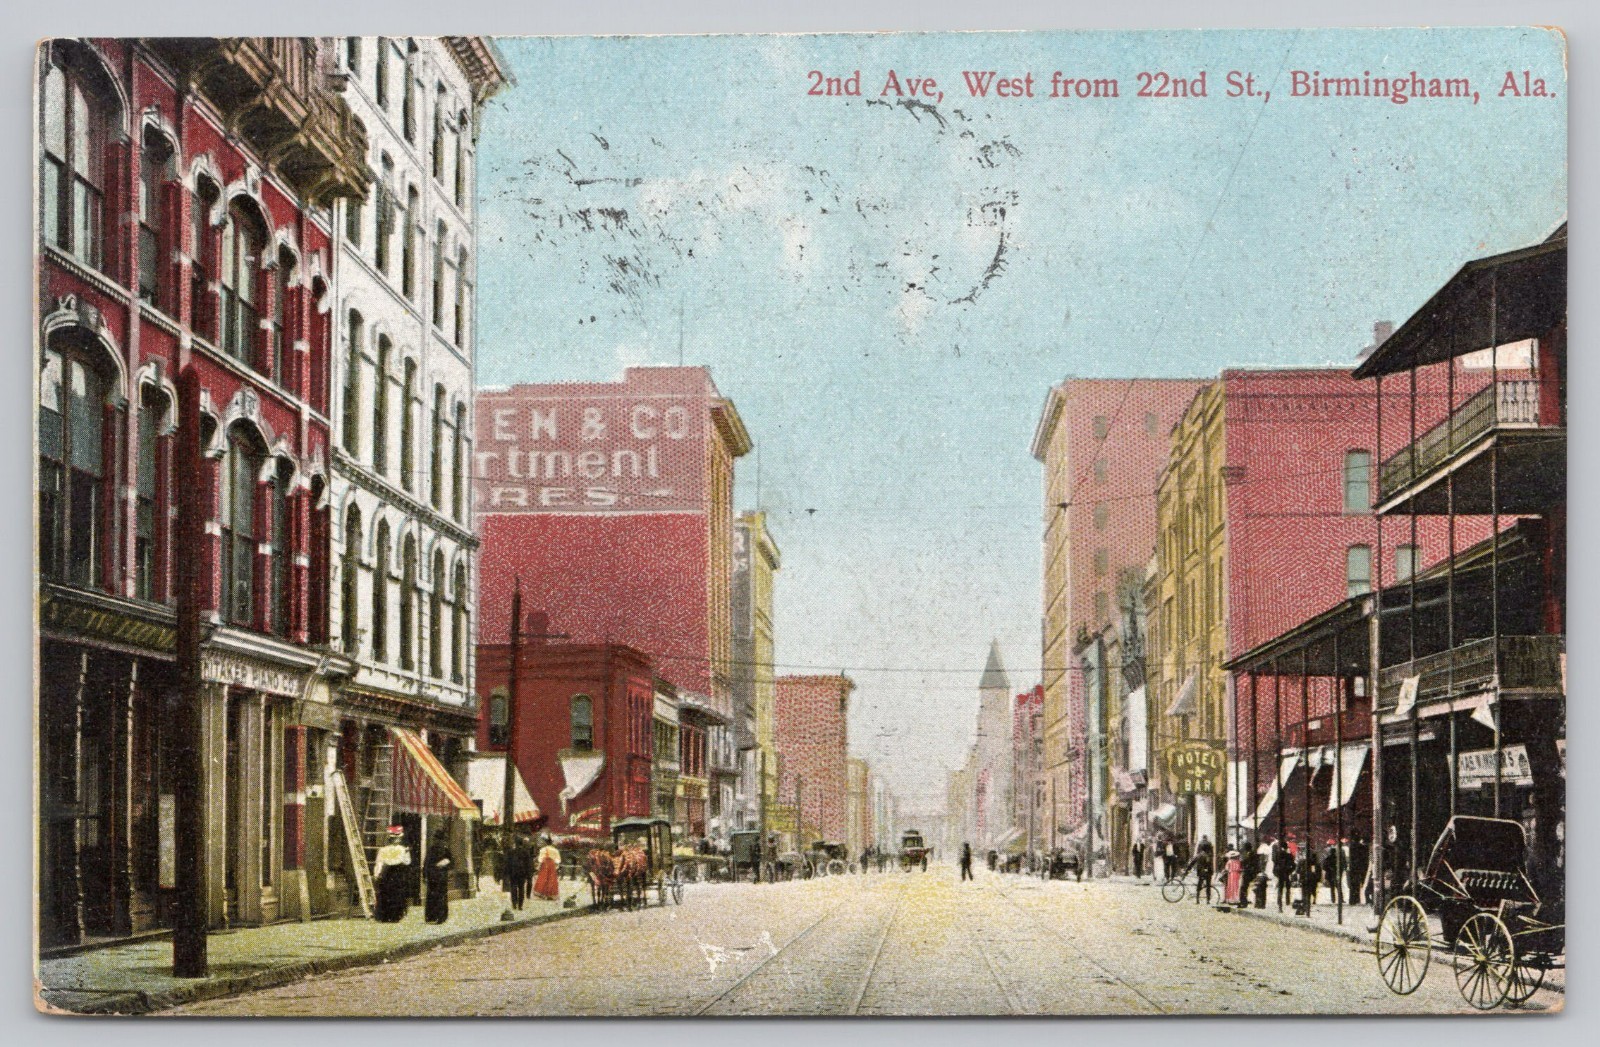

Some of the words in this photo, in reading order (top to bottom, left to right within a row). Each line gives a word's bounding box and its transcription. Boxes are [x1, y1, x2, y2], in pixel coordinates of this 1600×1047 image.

[579, 407, 606, 441] &
[1177, 751, 1216, 769] HOTEL
[1185, 779, 1211, 791] BAR
